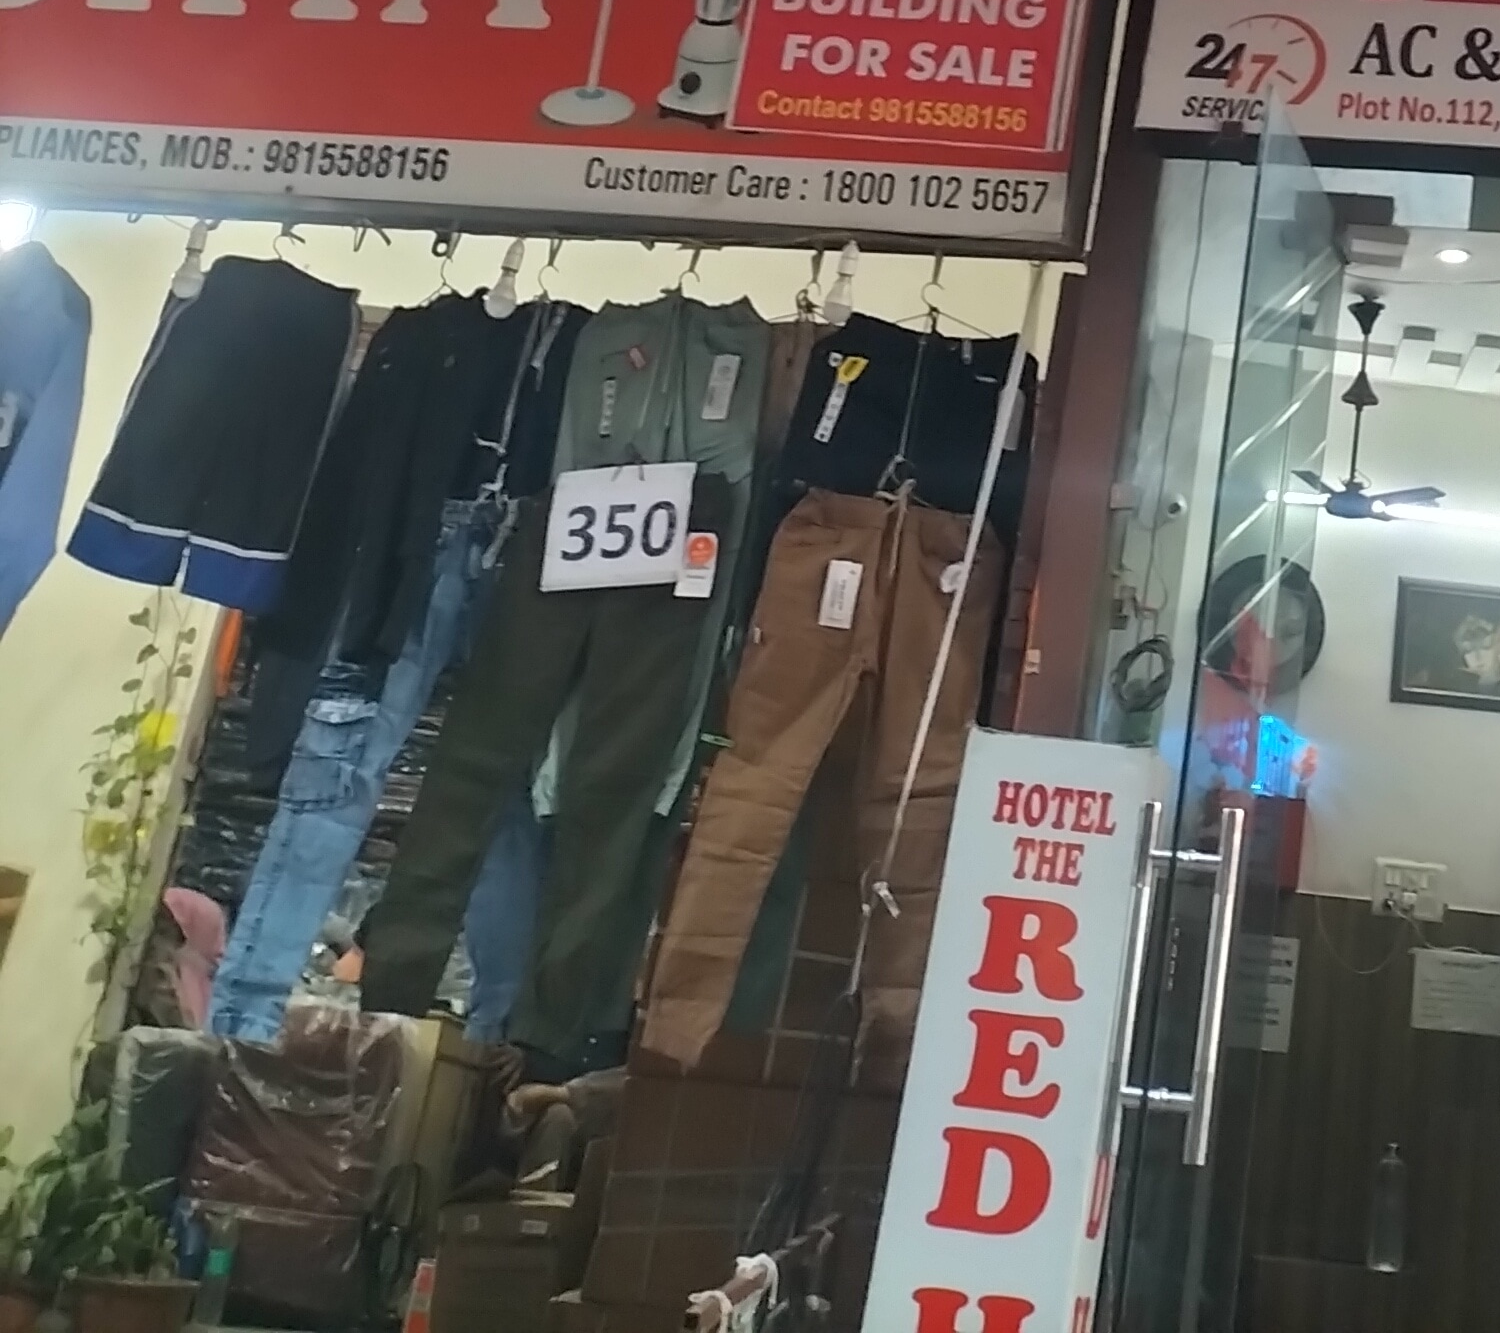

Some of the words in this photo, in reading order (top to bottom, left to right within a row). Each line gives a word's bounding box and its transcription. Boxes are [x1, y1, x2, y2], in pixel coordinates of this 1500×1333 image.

[780, 34, 891, 80] FOR
[904, 41, 1038, 89] SALE
[1349, 21, 1438, 79] AC
[757, 88, 863, 122] Contact
[868, 97, 1027, 132] 9815588156
[1182, 95, 1266, 121] SERVIC
[1337, 93, 1393, 121] Plot
[263, 139, 450, 183] 9815588156
[584, 155, 717, 197] Customer
[725, 165, 790, 201] Care
[823, 169, 895, 206] 1800
[908, 175, 961, 210] 102
[972, 180, 1050, 215] 5657
[562, 500, 677, 561] 350
[992, 780, 1117, 836] HOTEL
[1011, 836, 1085, 887] THE
[925, 895, 1084, 1235] RED
